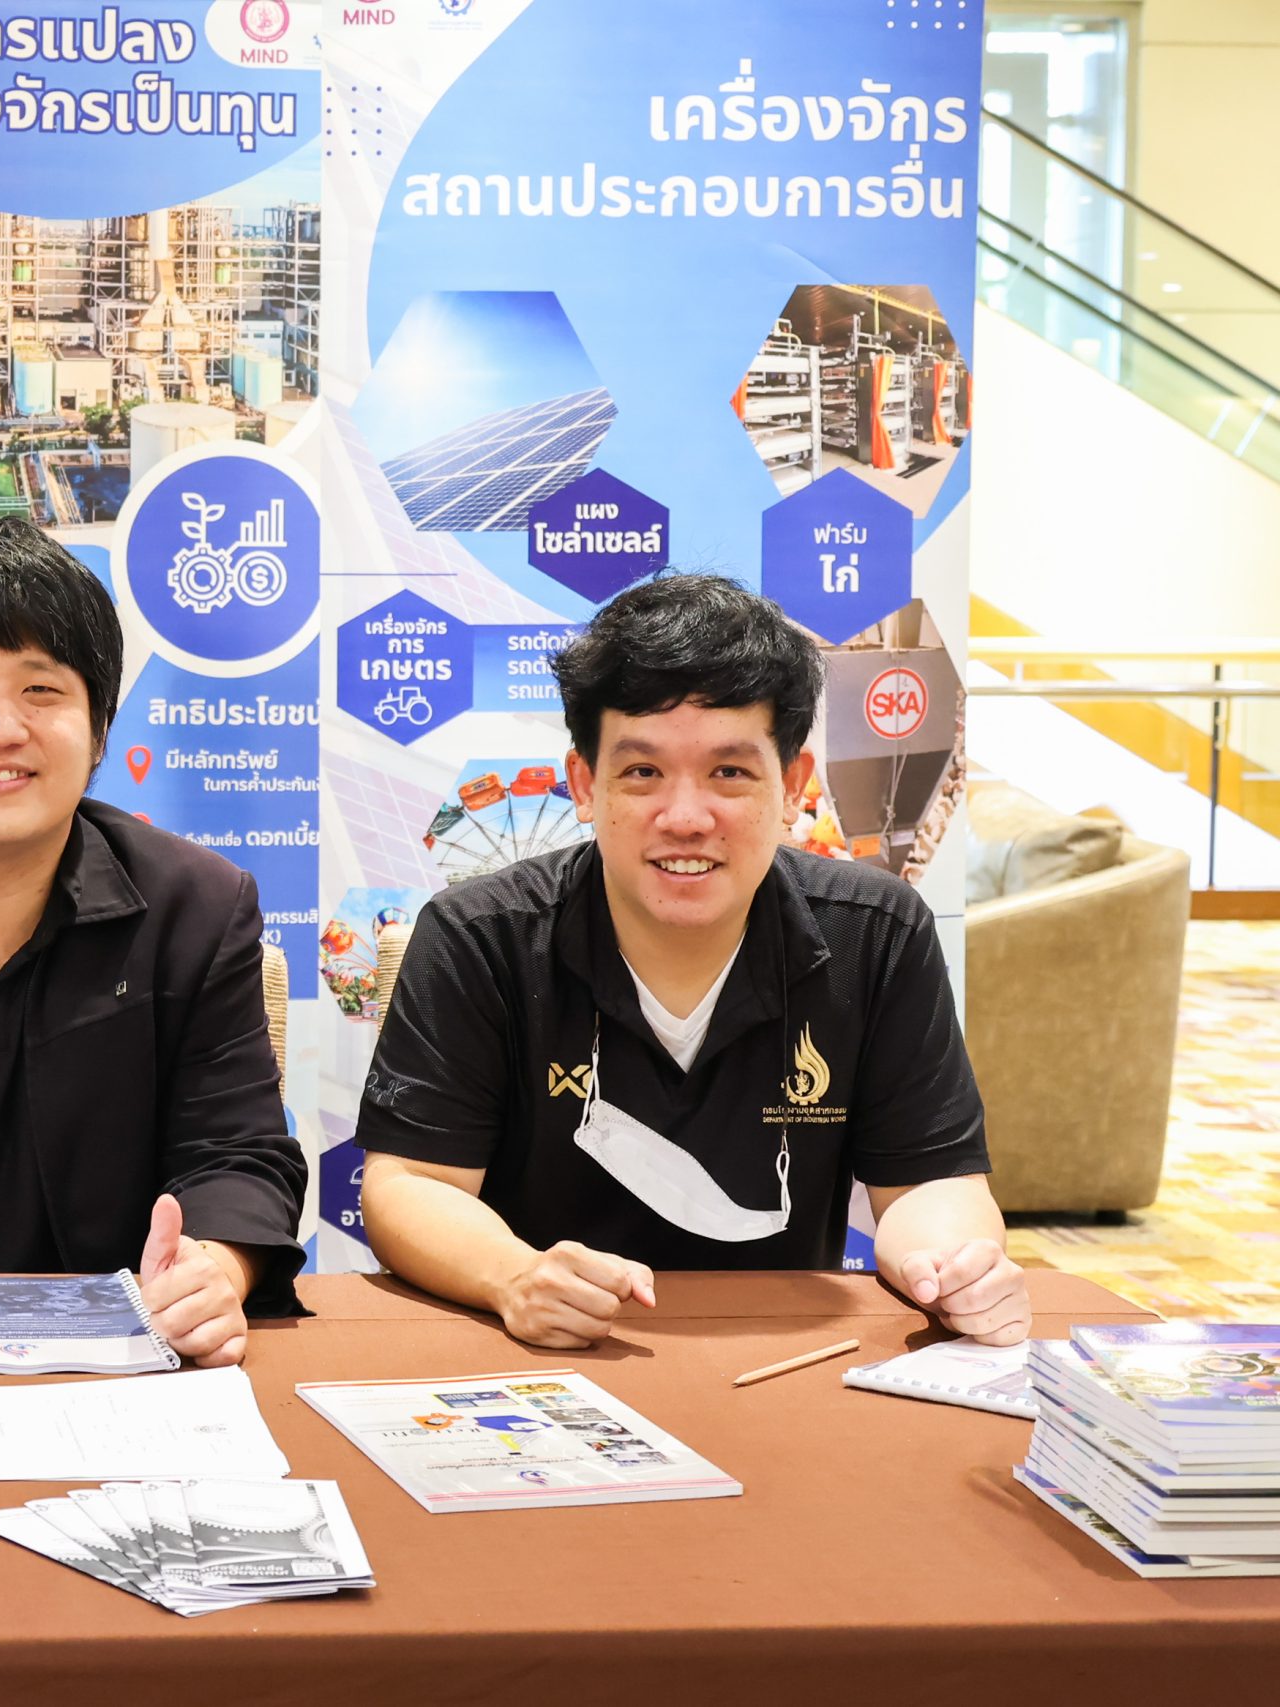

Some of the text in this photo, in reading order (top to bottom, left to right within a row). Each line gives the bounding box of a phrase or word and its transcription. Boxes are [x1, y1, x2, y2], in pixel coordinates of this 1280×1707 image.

[343, 9, 396, 26] MIND
[240, 49, 289, 65] MIND
[649, 58, 968, 144] เครื่องจักร
[402, 144, 964, 219] สถานประกอบการอื่น
[575, 503, 619, 521] แผง
[534, 523, 663, 555] โซล่าเซลล์
[813, 523, 868, 546] ฟาร์ม
[819, 553, 860, 594] ไก่
[365, 613, 448, 636] เครื่องจักร
[387, 638, 425, 654] การ
[360, 658, 453, 681] เกษตร
[871, 693, 922, 719] SKA
[165, 749, 279, 769] มีหลักทรัพย์
